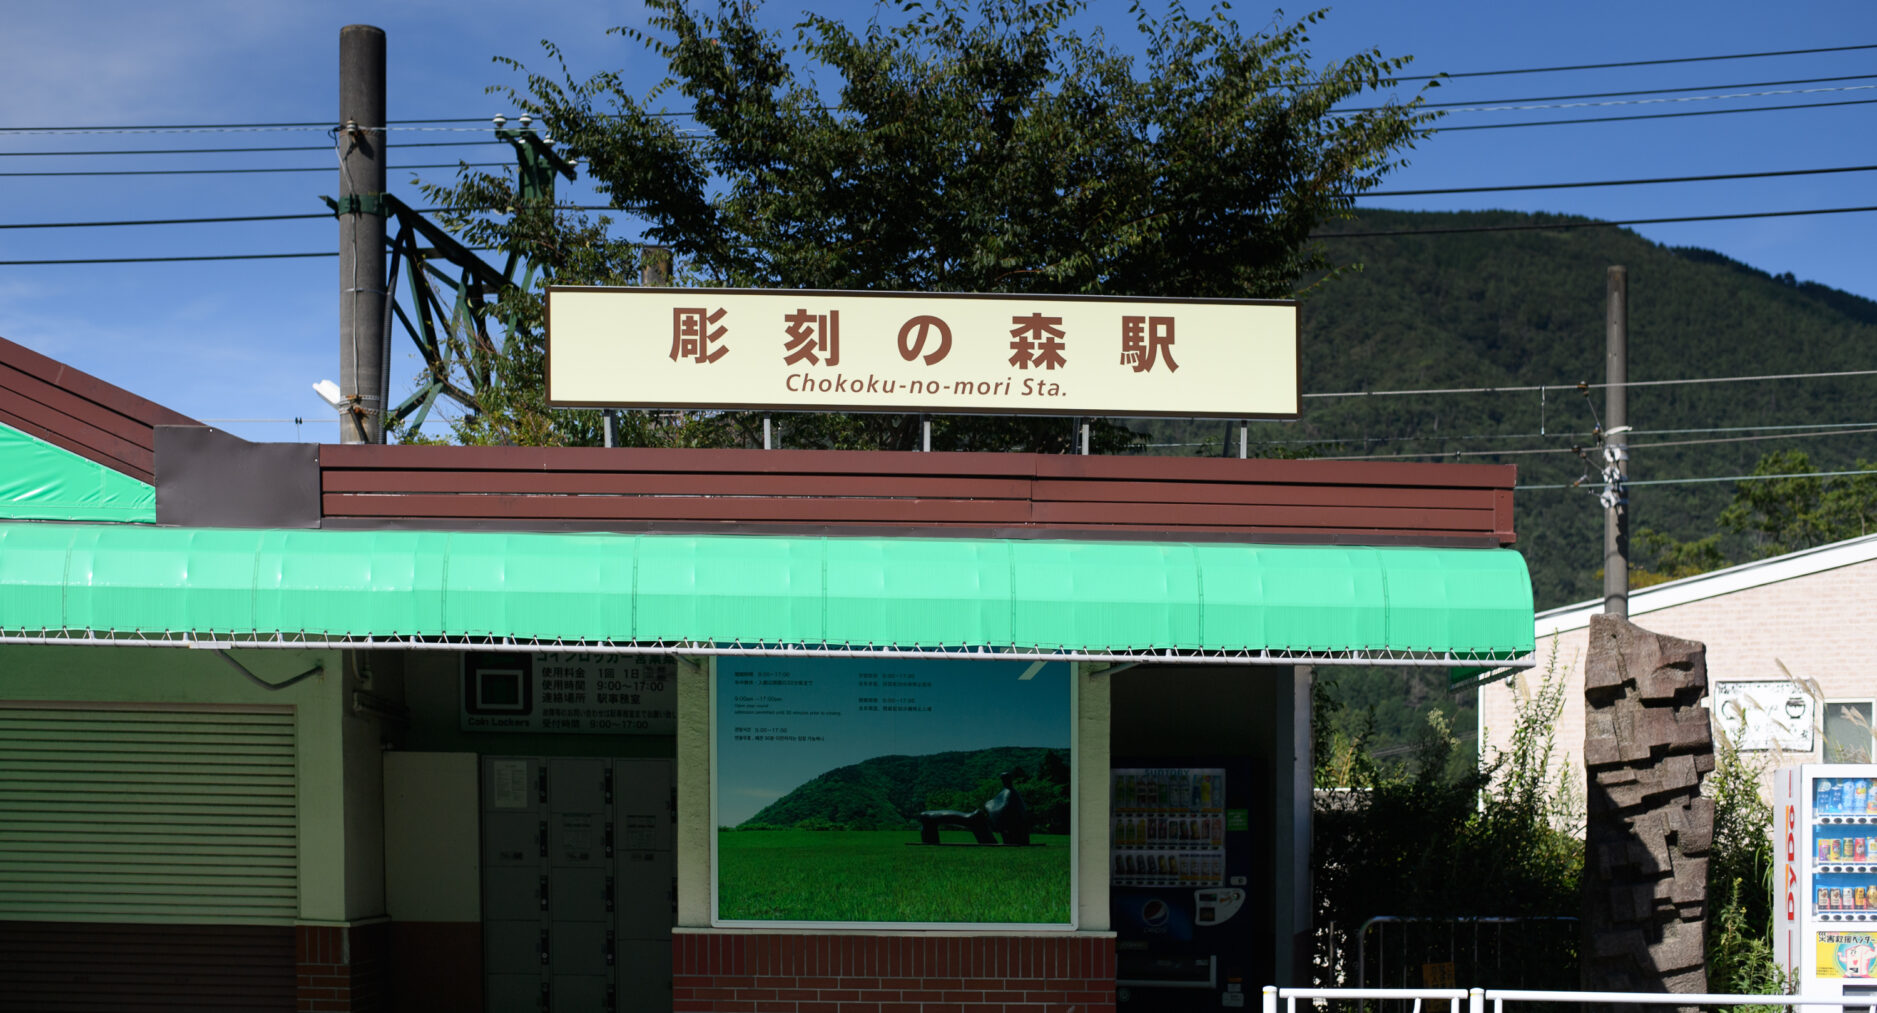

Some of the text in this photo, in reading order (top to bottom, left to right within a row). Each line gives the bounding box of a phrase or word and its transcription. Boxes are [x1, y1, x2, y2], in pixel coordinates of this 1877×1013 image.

[669, 308, 1179, 373] 彫刻の森駅
[787, 373, 1067, 398] Chokoku-no-mori Sta.
[542, 667, 585, 678] 使用料金
[624, 669, 639, 679] 1日
[542, 680, 585, 690] 使用時間
[542, 692, 640, 704] 連絡場所 駅事務室
[468, 717, 530, 728] Coin Lockers
[542, 719, 580, 729] 受付時間
